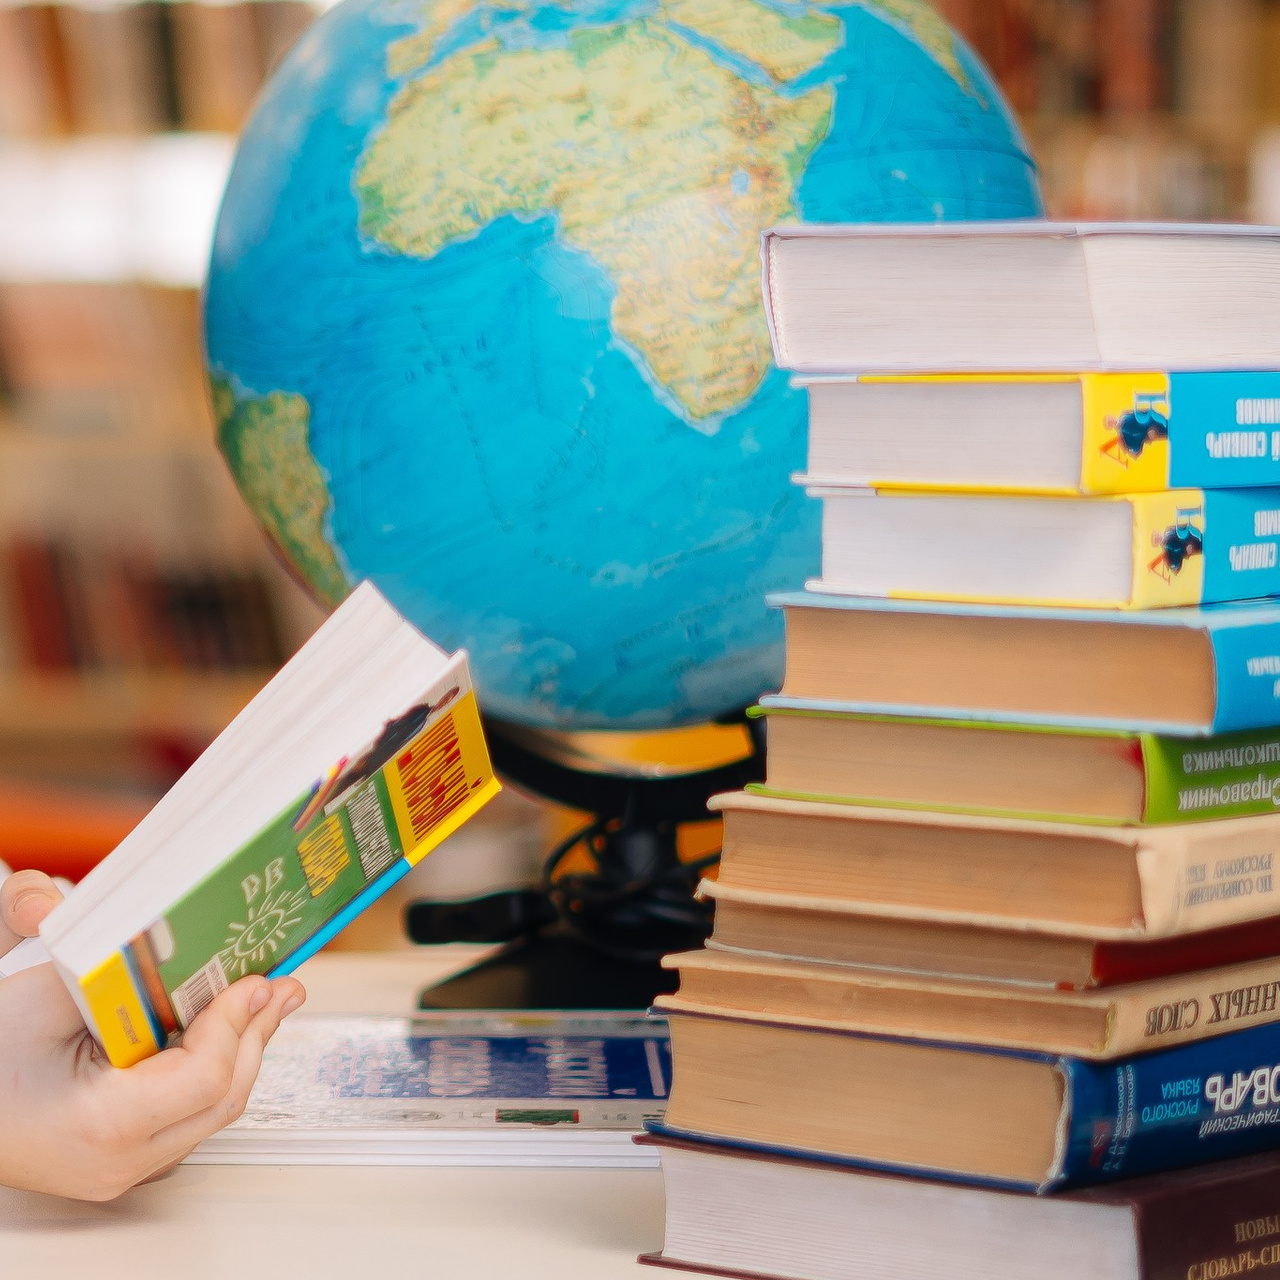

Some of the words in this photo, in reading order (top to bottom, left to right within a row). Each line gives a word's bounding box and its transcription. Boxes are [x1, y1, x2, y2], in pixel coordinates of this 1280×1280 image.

[1206, 431, 1266, 458] СЛОВАРЬ
[1229, 543, 1277, 571] СЛОВАРЬ
[394, 711, 485, 842] ШКОЛЬНЫЙ
[344, 779, 399, 881] ЭТИМОЛОГИЧЕСКИЙ
[295, 810, 352, 900] СЛОВАРЬ
[1143, 997, 1200, 1039] СЛОВ
[1207, 981, 1280, 1026] ННЫХ
[1161, 1076, 1200, 1099] ЯЗЫКА
[1141, 1099, 1199, 1123] РУССКОГО
